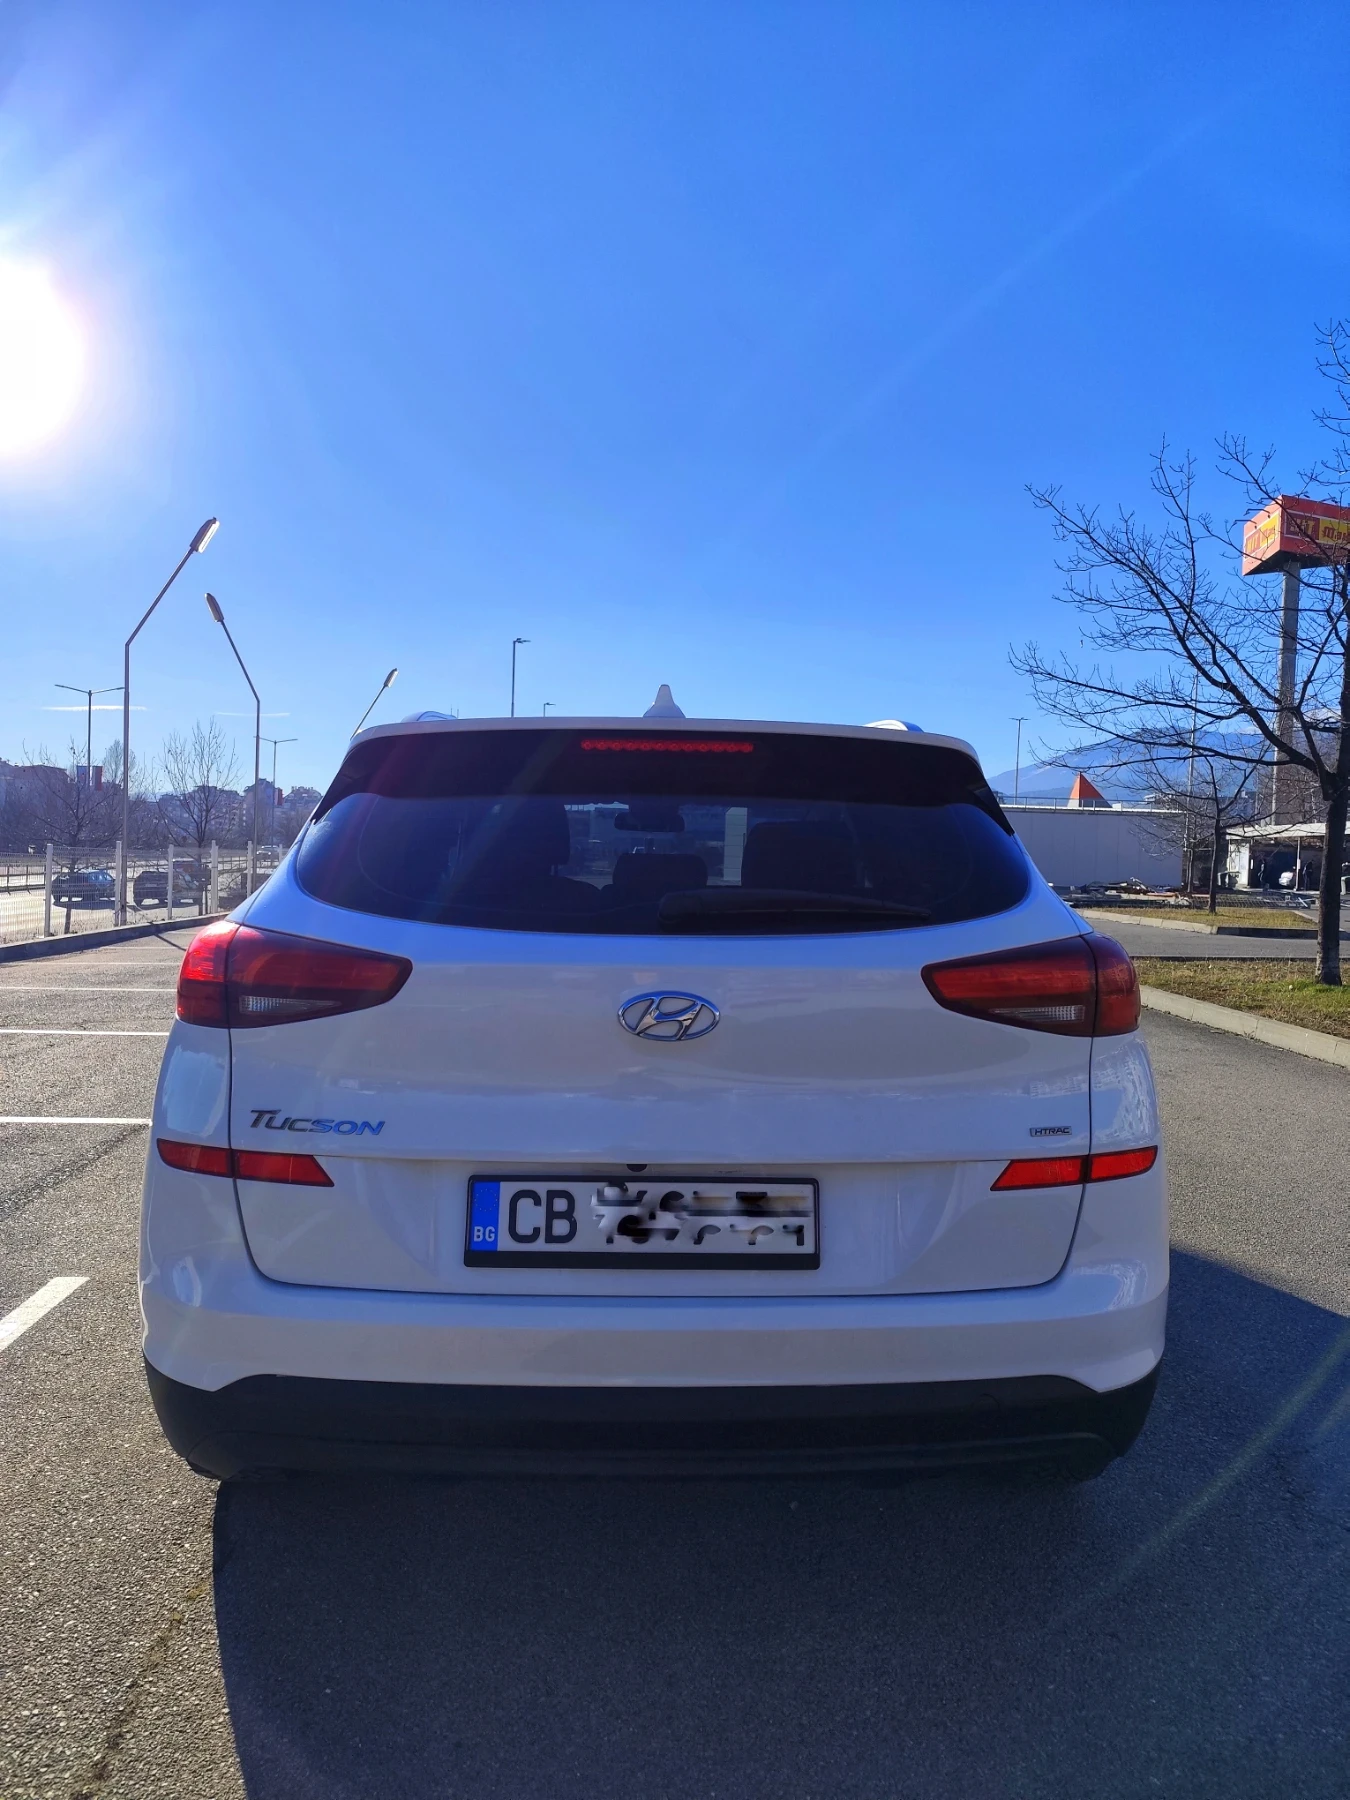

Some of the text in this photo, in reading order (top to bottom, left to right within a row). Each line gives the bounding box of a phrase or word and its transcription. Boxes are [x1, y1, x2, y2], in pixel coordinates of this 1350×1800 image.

[250, 1109, 386, 1136] TUCSON
[1034, 1127, 1070, 1136] HTRAC
[508, 1189, 578, 1244] CB
[474, 1226, 495, 1242] BG
